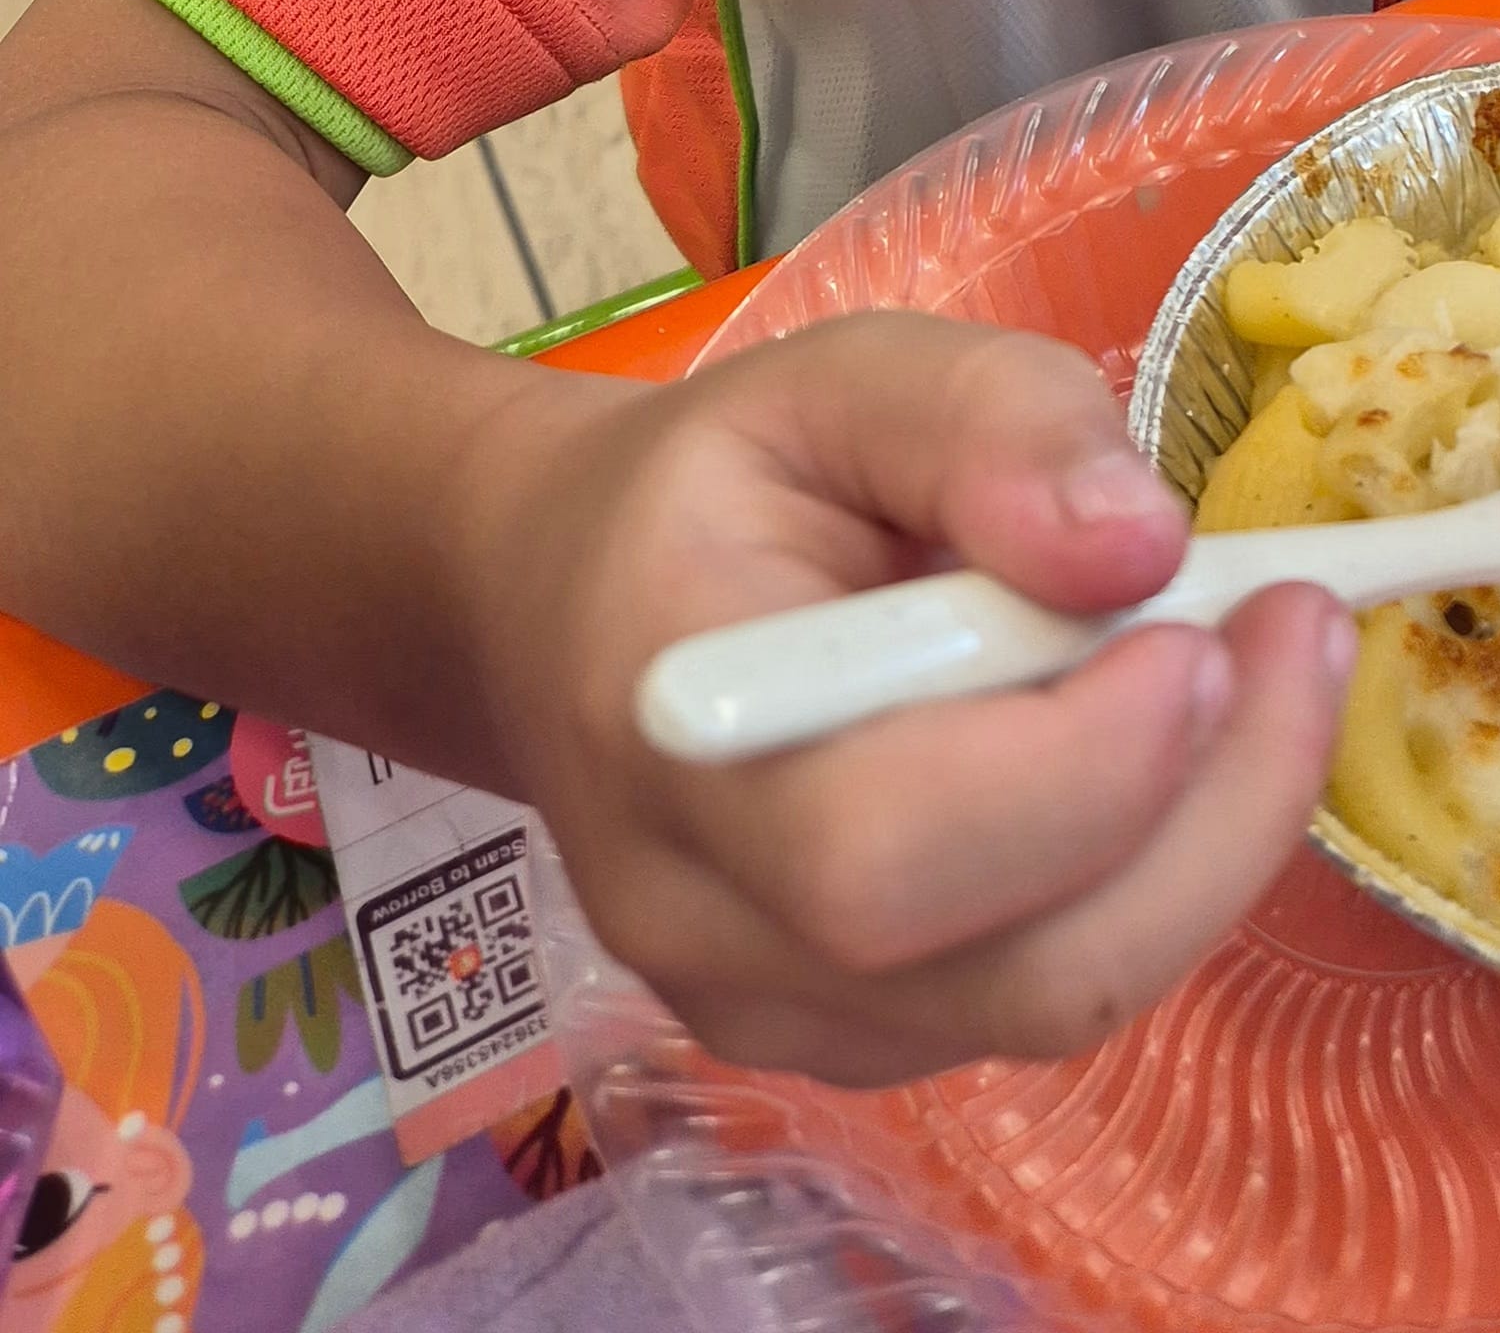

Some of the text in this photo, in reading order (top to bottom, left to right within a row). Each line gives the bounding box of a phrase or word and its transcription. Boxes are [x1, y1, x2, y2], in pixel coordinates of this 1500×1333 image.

[372, 838, 526, 923] Scan to Borrow
